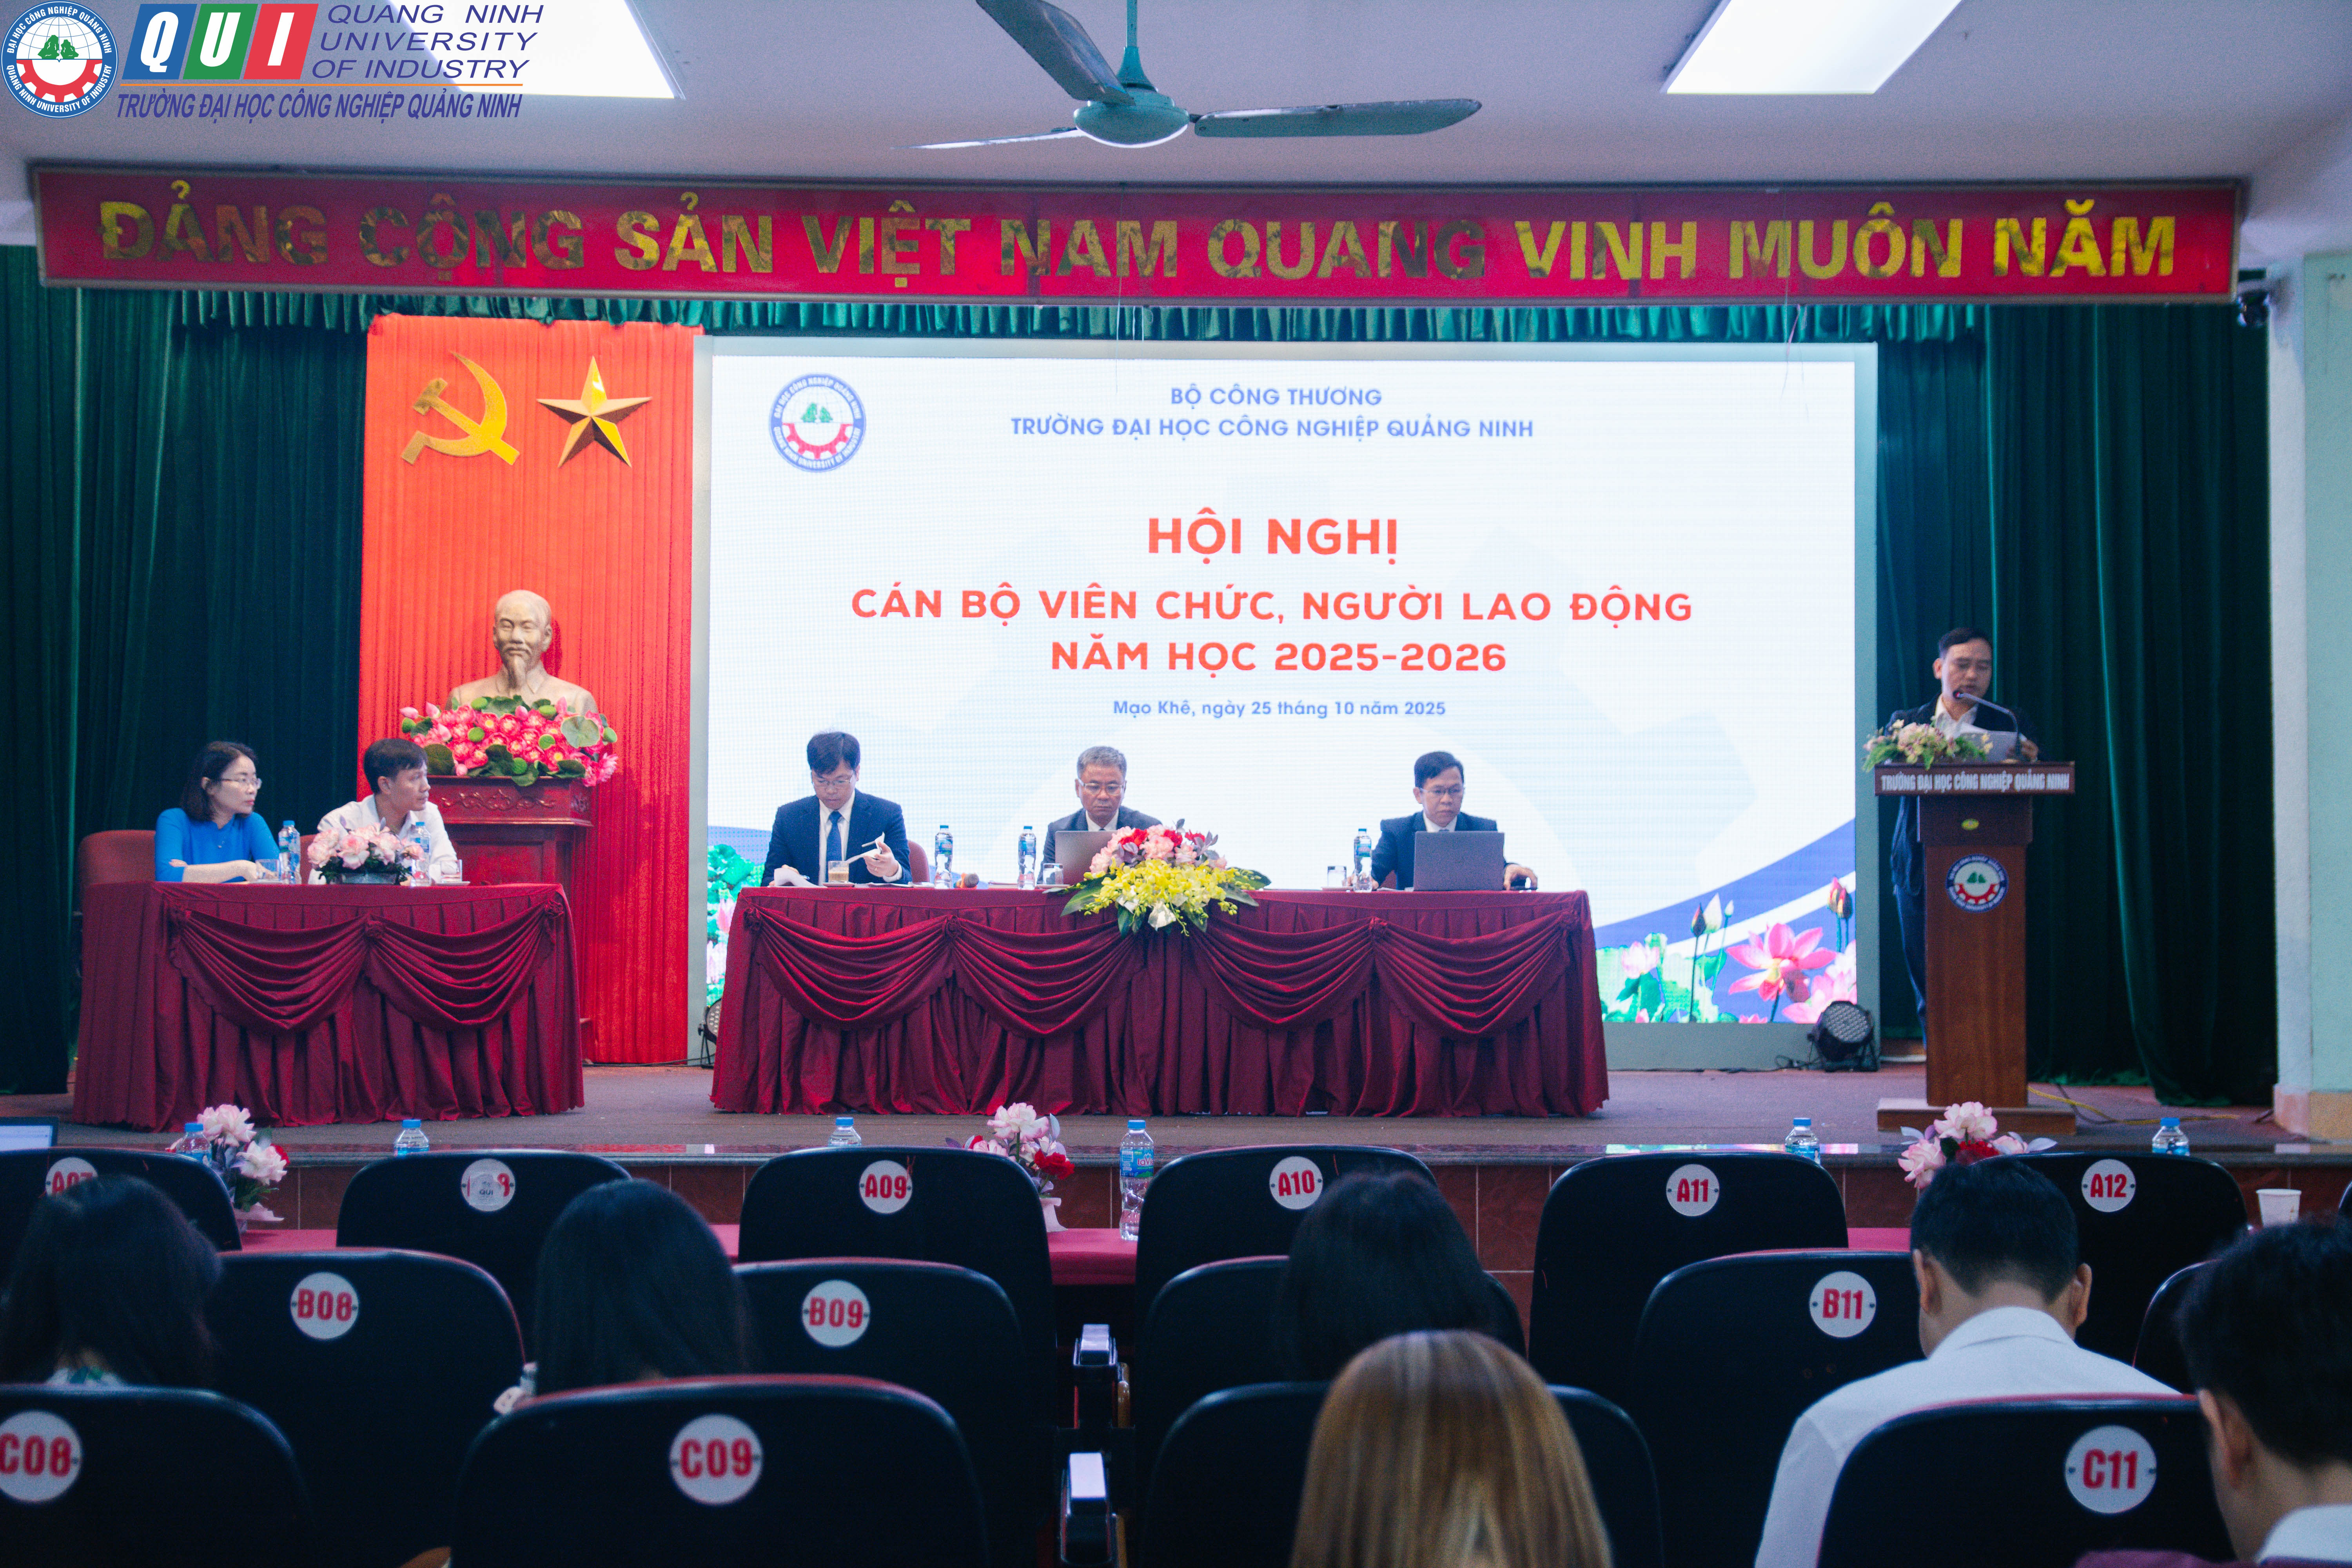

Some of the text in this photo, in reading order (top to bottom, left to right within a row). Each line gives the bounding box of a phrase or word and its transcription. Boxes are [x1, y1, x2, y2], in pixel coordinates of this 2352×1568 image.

[98, 180, 2176, 288] ĐẢNG CỘNG SẢN VIỆT NAM QUANG VINH MUÔN NĂM
[1171, 383, 1382, 409] BỘ CÔNG THƯƠNG
[1011, 413, 1533, 442] TRƯỜNG ĐẠI HỌC CÔNG NGHIỆP QUẢNG NINH
[1149, 507, 1397, 564] HỘI NGHỊ
[852, 582, 1691, 628] CÁN BỘ VIÊN CHỨC, NGƯỜI LAO ĐỘNG
[1051, 633, 1506, 678] NĂM HỌC 2025-2026
[1113, 700, 1446, 719] Mạo Khê, ngày 25 tháng 10 năm 2025
[1953, 771, 1978, 790] CÔNG
[1980, 770, 2013, 793] NGHIỆP
[2014, 768, 2045, 792] QUẢNG
[2046, 773, 2070, 790] NINH
[865, 1174, 907, 1199] A09
[1278, 1170, 1315, 1196] A10
[1677, 1179, 1708, 1202] A11
[2091, 1174, 2127, 1198] A12
[298, 1289, 352, 1321] B08
[809, 1297, 863, 1328] B09
[1823, 1289, 1862, 1319] B11
[0, 1434, 71, 1476] C08
[681, 1438, 752, 1478] C09
[2083, 1449, 2137, 1488] C11
